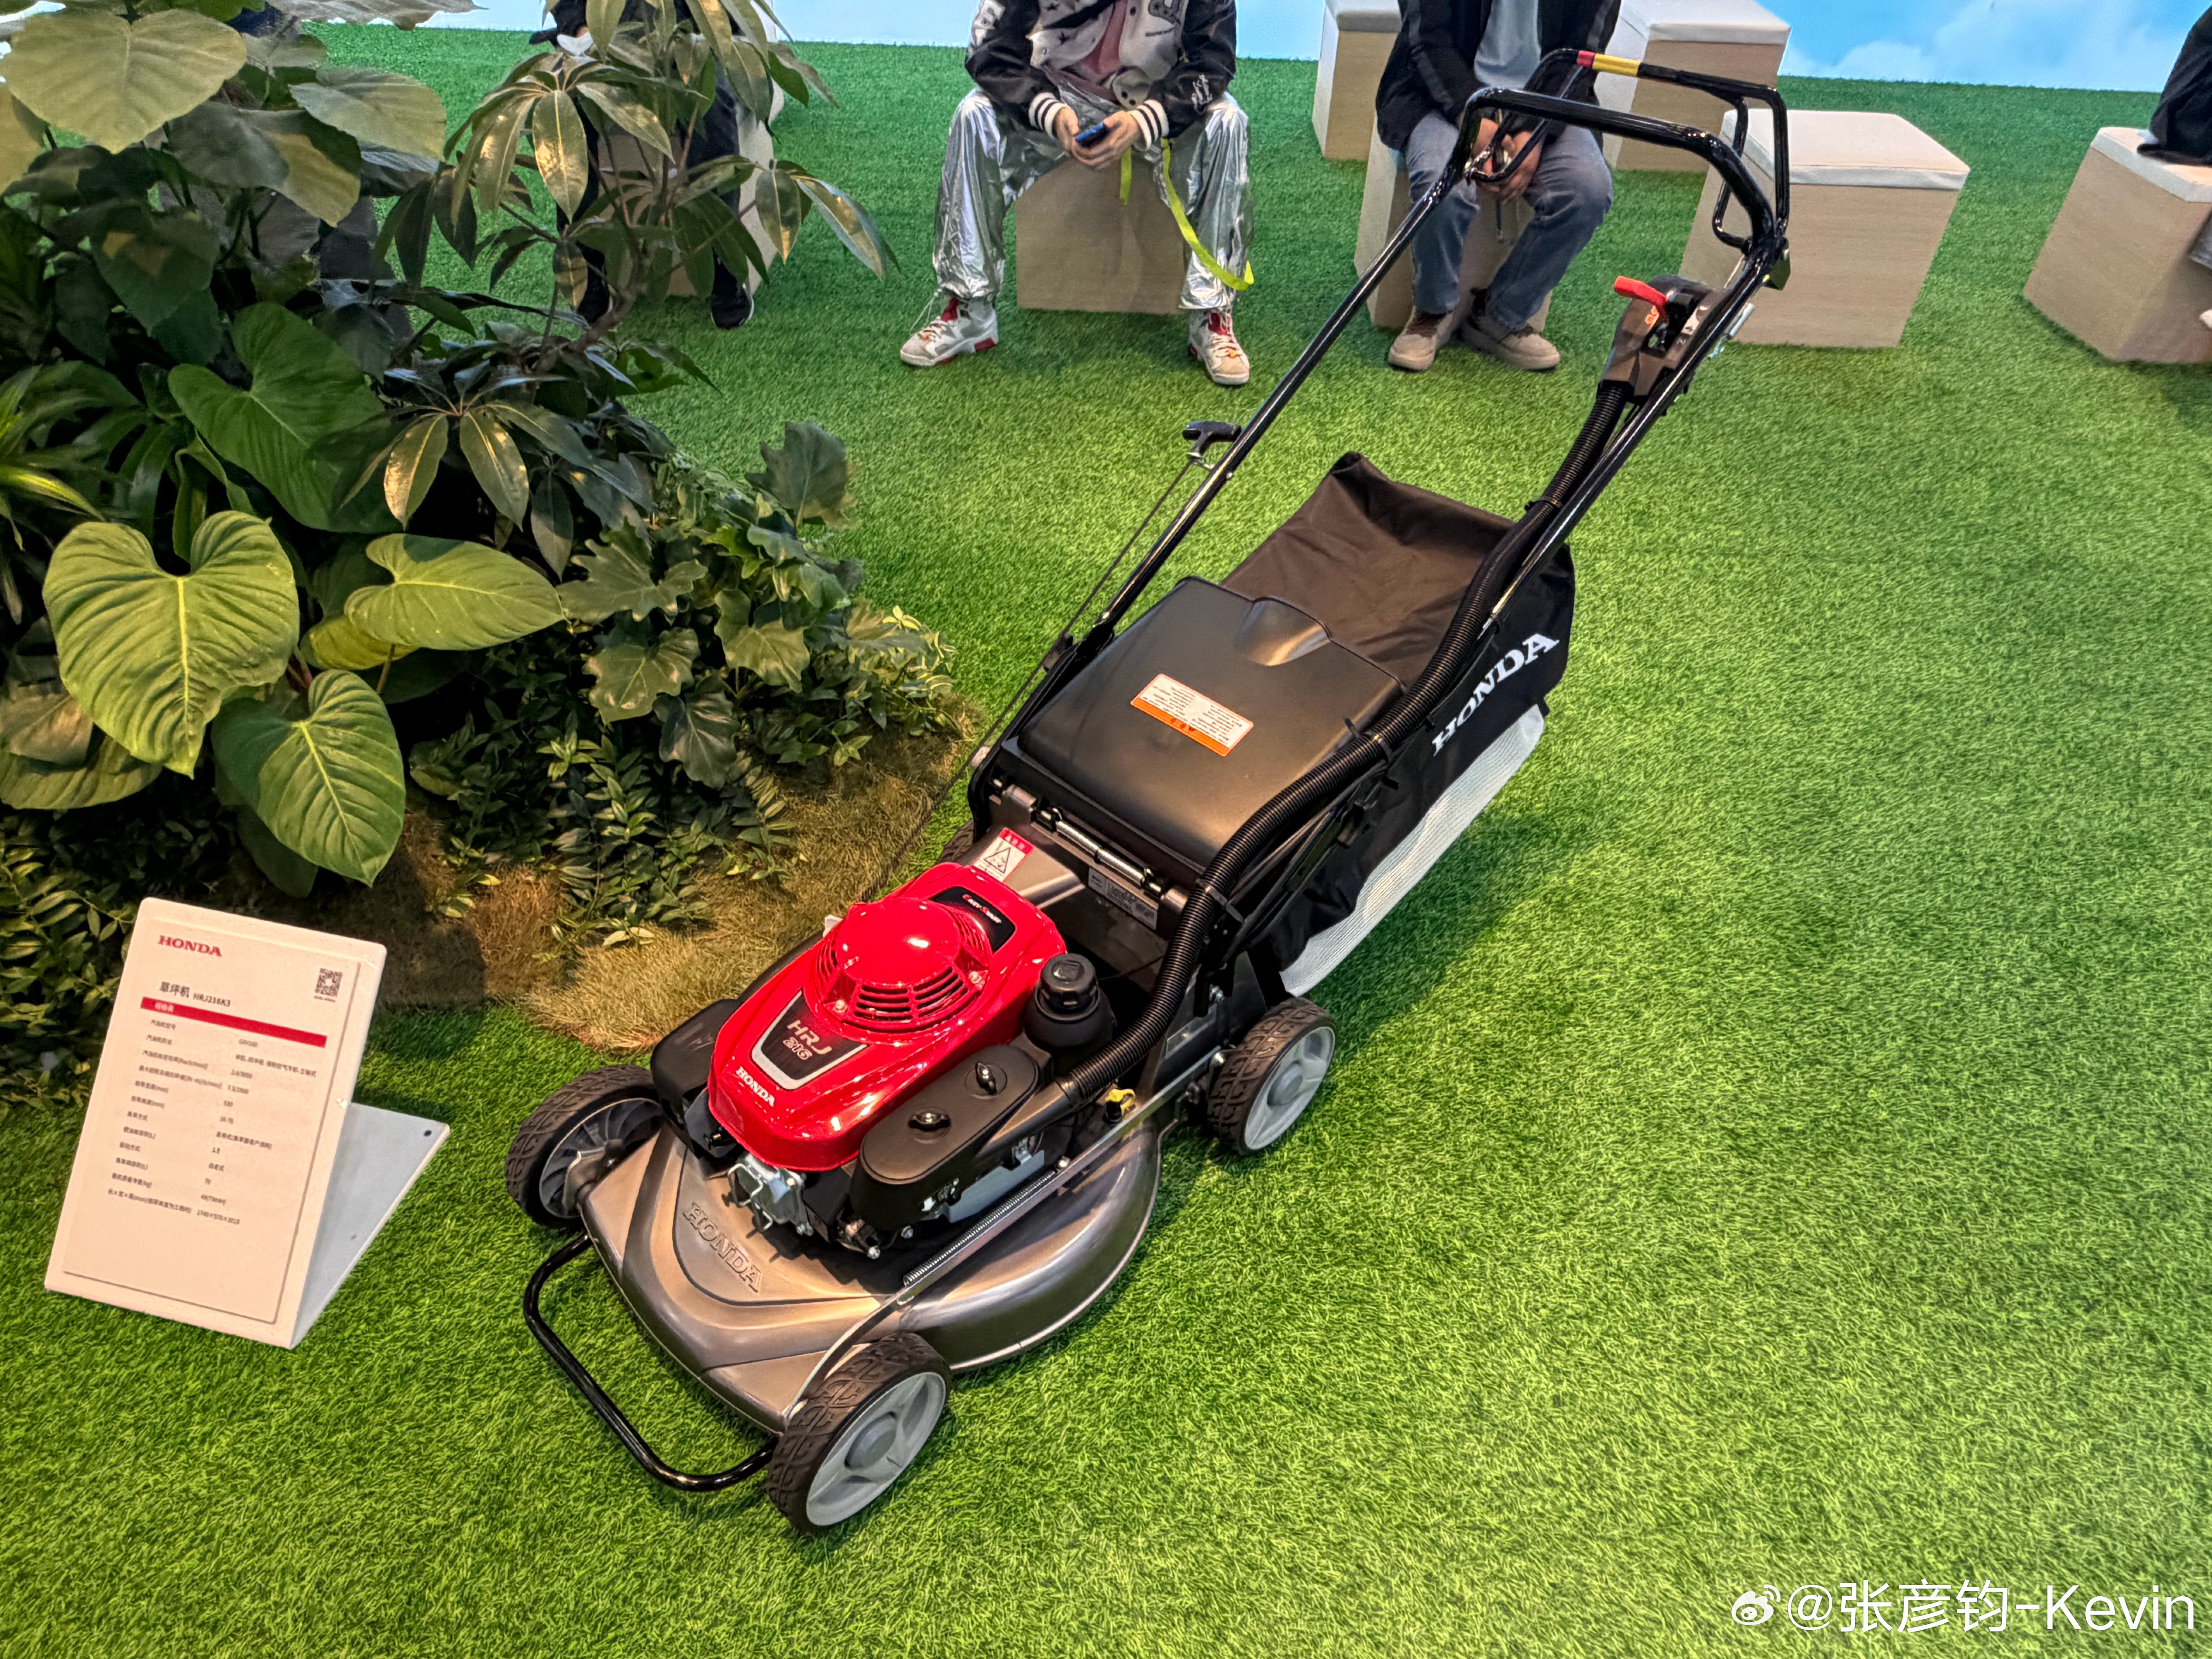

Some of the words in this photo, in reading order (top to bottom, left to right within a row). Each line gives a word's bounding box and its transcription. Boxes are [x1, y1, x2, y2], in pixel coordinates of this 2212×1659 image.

[1432, 633, 1559, 757] HONDA
[158, 935, 222, 957] HONDA
[159, 981, 190, 998] 草坪机
[783, 1036, 812, 1060] 216
[787, 1020, 832, 1055] HRJ
[736, 1066, 775, 1107] HONDA
[682, 1202, 763, 1293] HONDA
